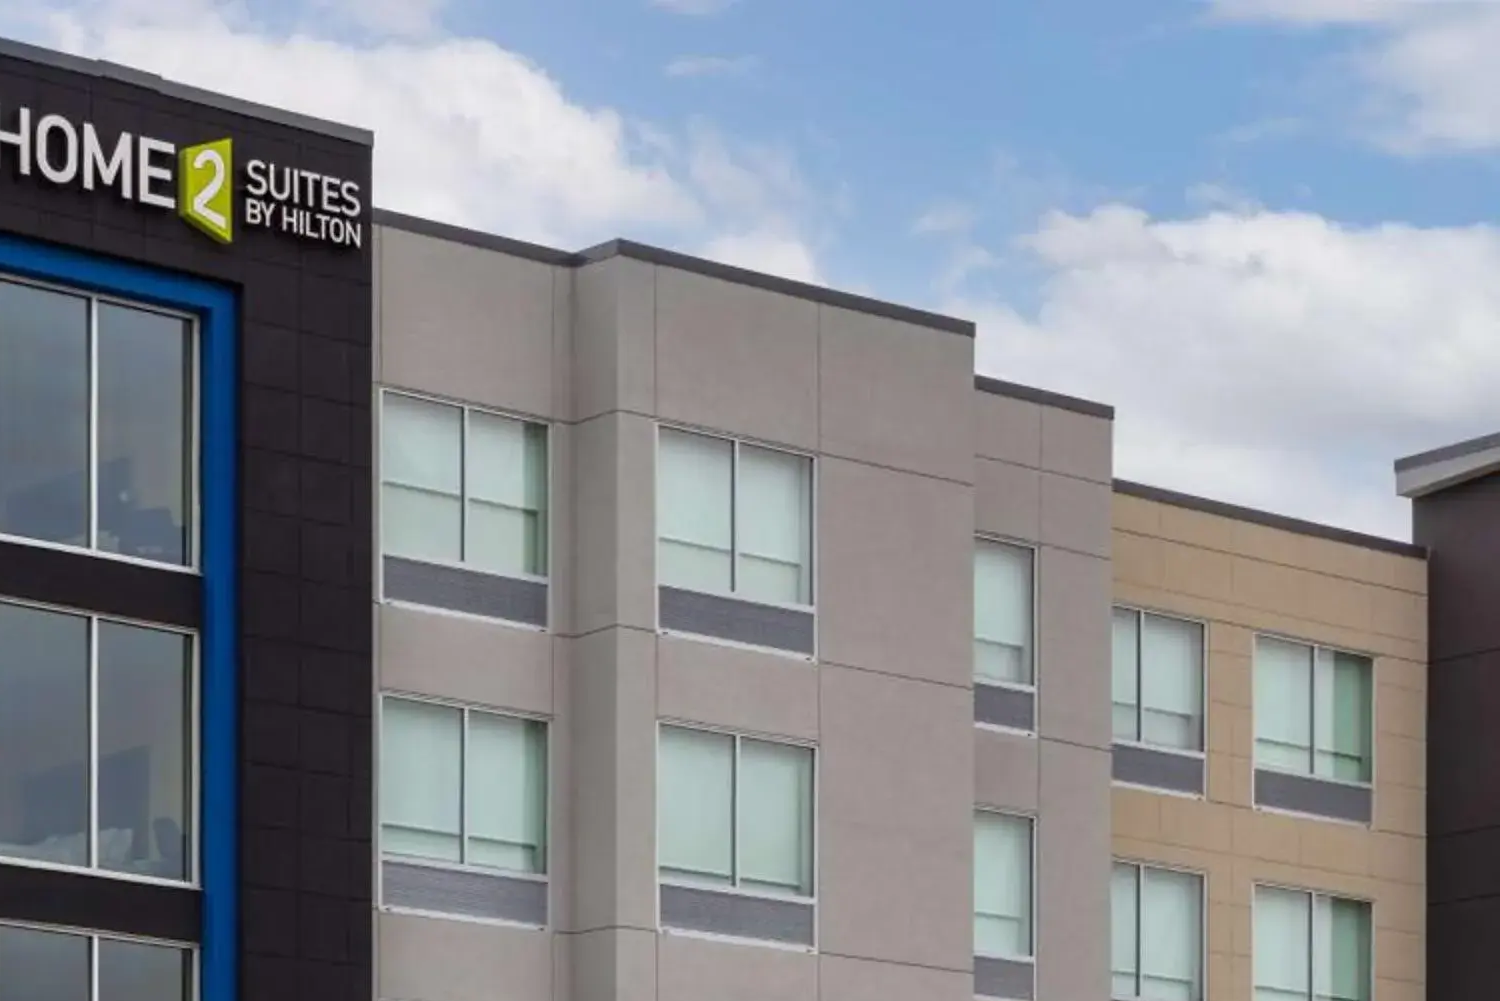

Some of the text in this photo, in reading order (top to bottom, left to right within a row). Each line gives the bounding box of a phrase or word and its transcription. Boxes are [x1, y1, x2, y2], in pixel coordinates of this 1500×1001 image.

[193, 149, 228, 230] 2
[246, 159, 361, 217] SUITES
[245, 197, 362, 249] BY HILTON
